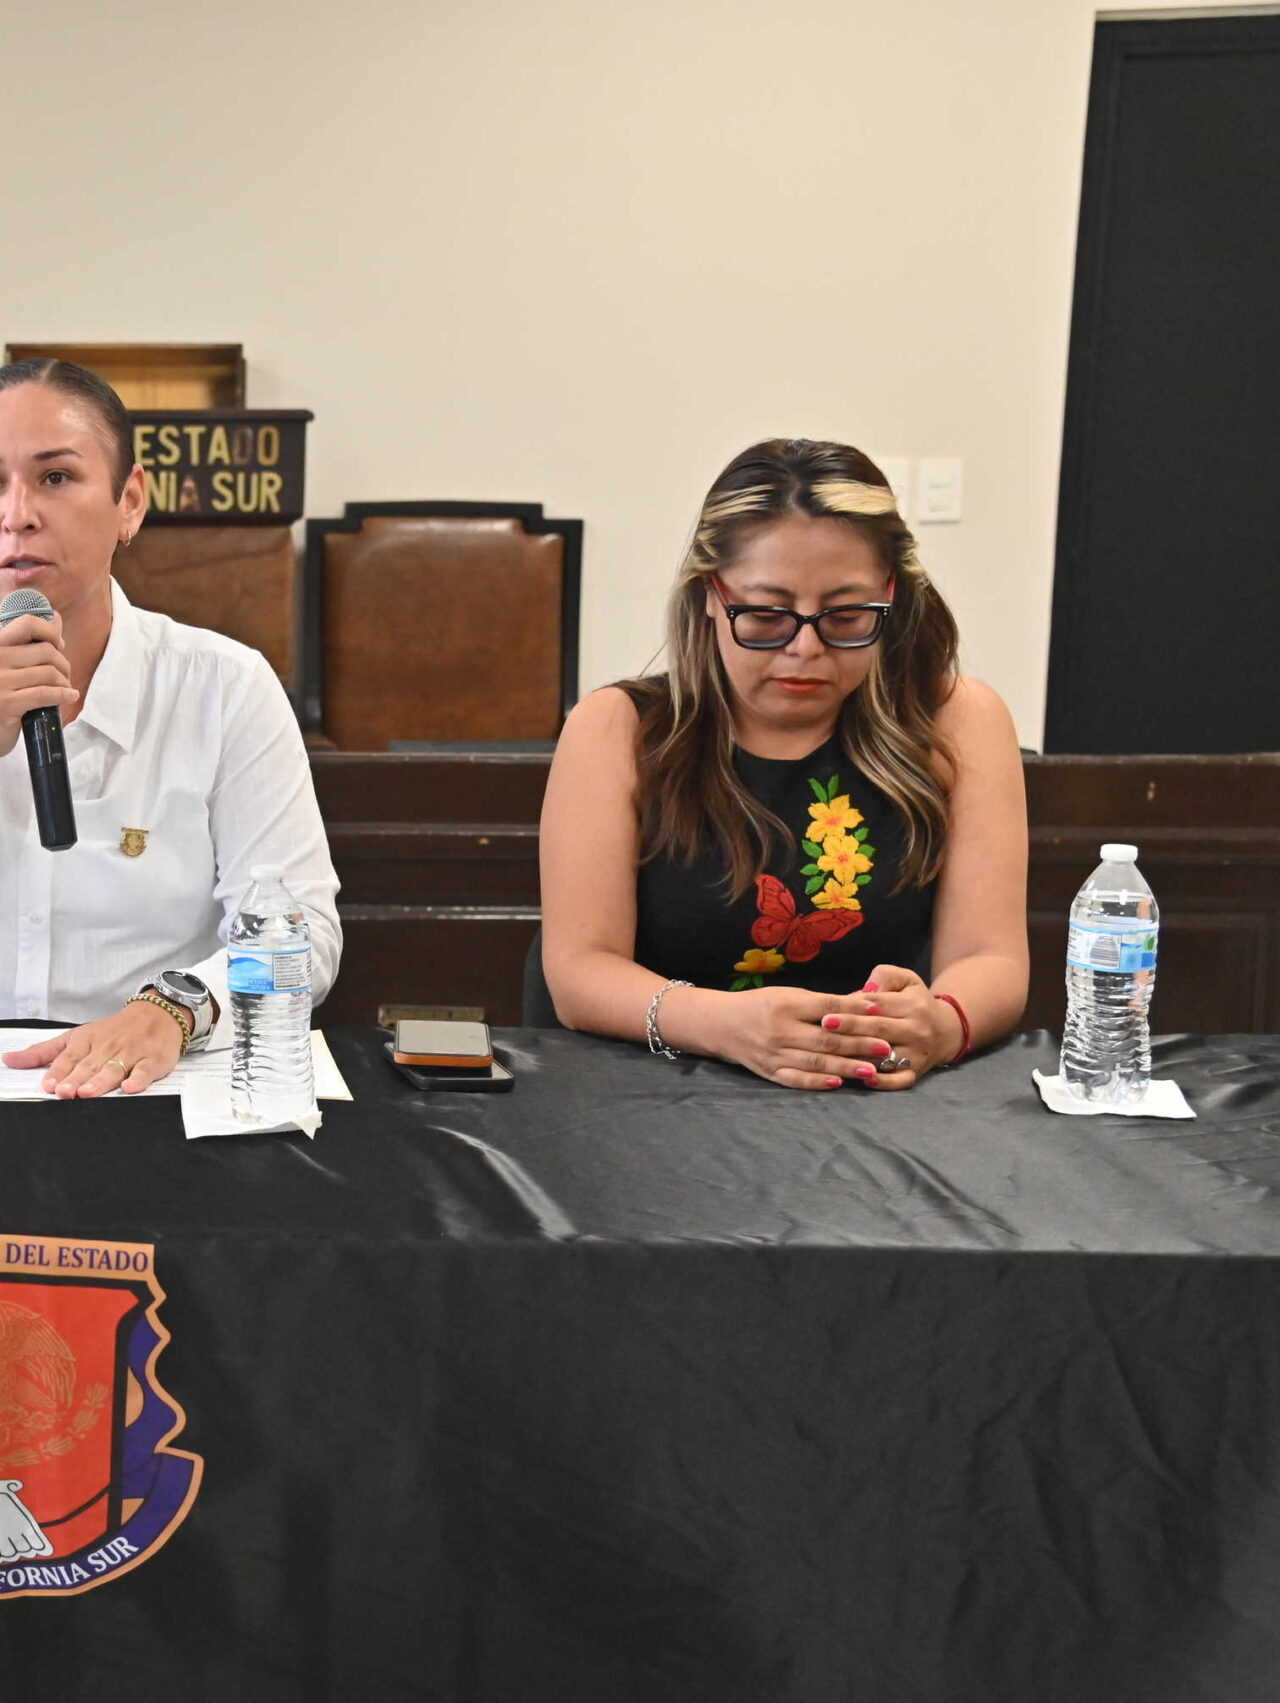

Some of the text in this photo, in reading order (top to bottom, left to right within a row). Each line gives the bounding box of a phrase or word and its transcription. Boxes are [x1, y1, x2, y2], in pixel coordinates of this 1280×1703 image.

[133, 423, 280, 467] ESTADO
[211, 470, 283, 513] SUR
[5, 1243, 51, 1267] DEL
[57, 1246, 149, 1273] ESTADO
[86, 1536, 139, 1573] SUR
